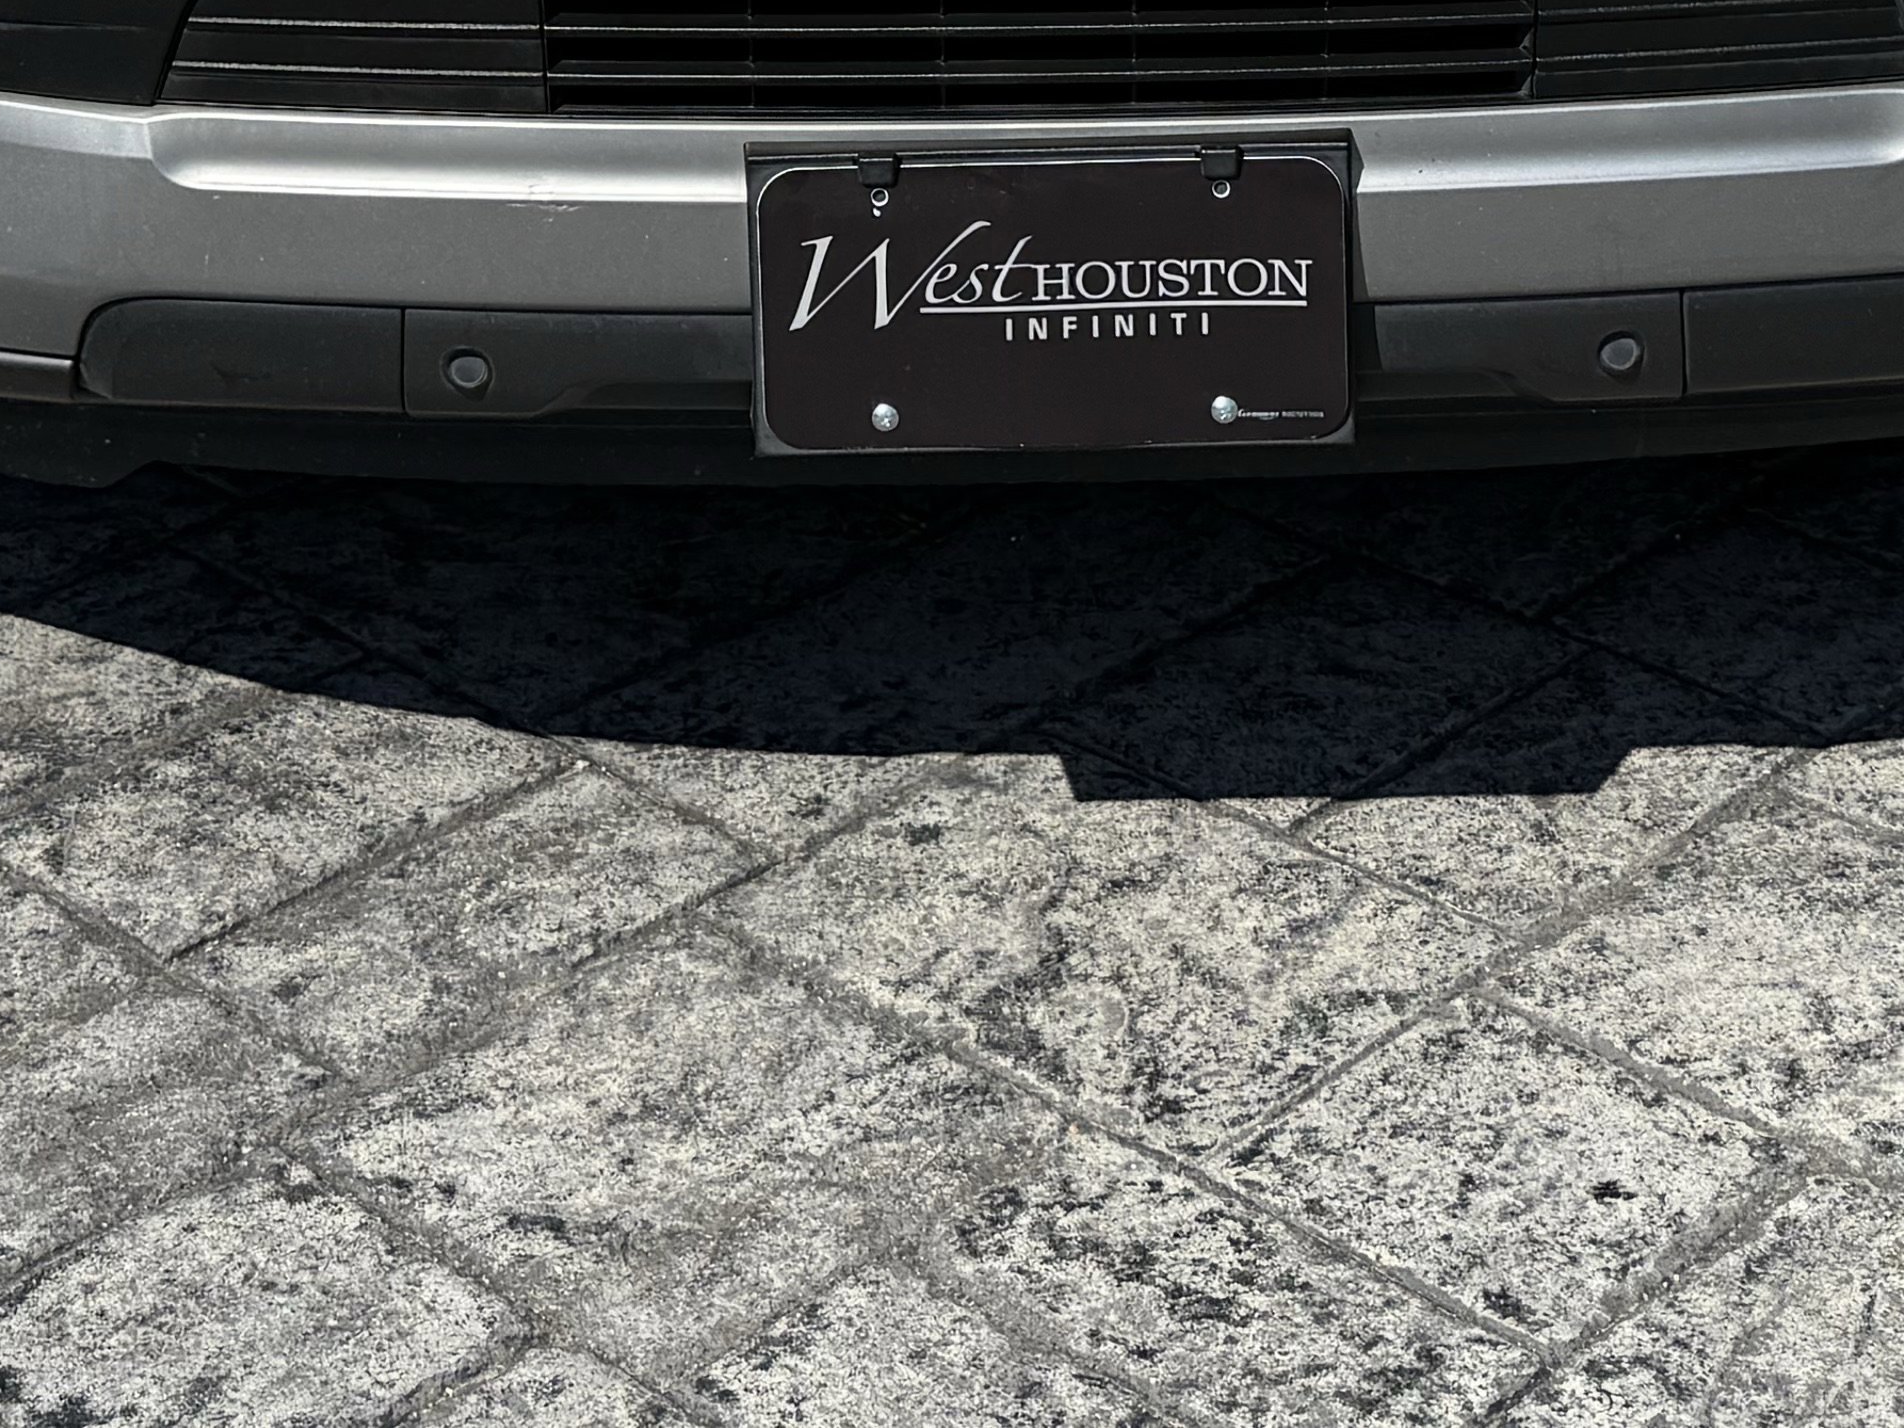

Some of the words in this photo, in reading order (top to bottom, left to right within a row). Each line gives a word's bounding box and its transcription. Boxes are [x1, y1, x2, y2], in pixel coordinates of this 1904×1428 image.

[789, 220, 1037, 331] West
[1030, 256, 1313, 302] HOUSTON
[1004, 311, 1211, 341] INFINITI
